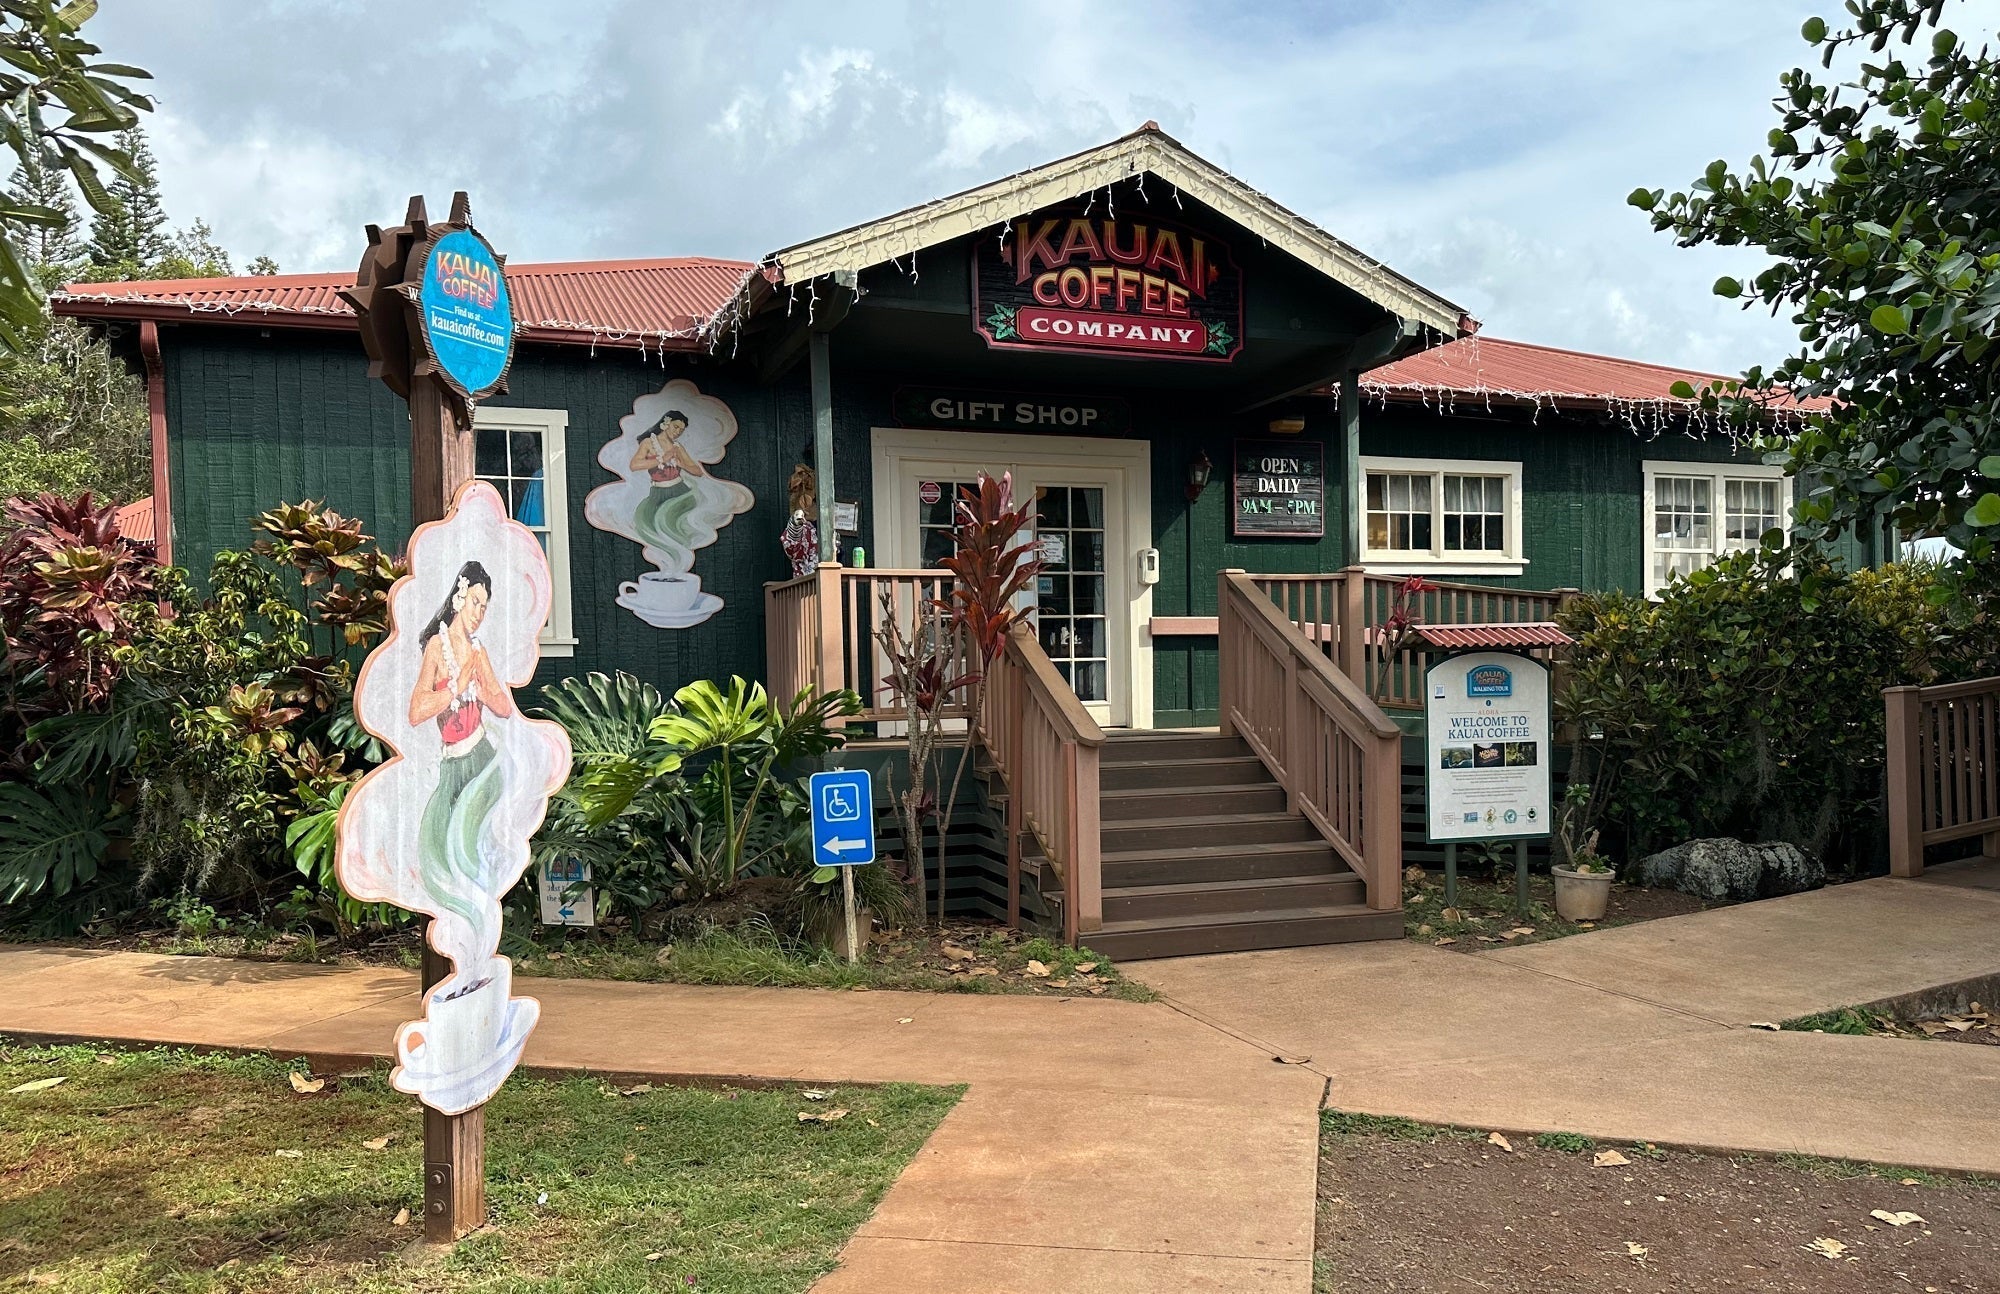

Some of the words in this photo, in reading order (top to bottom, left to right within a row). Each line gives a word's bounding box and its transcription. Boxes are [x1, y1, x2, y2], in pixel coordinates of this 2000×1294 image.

[464, 213, 473, 225] N
[1015, 218, 1206, 300] KAUAI
[436, 251, 498, 300] KAUAI
[408, 286, 419, 301] W
[442, 277, 494, 309] COFFEE
[1032, 264, 1191, 318] COFFEE
[454, 306, 468, 318] Find
[467, 312, 475, 320] us
[431, 311, 505, 347] kauaicoffee.com
[514, 321, 521, 333] E
[1030, 317, 1195, 344] COMPANY
[467, 397, 475, 411] S
[930, 398, 1005, 422] GIFT
[1015, 403, 1098, 426] SHOP
[1260, 457, 1299, 474] OPEN
[1257, 478, 1301, 494] DAILY
[1242, 498, 1273, 514] 9AM
[1287, 499, 1316, 515] 5PM
[1475, 671, 1506, 680] KAUAI
[1451, 716, 1509, 728] WELCOME
[1511, 715, 1527, 726] TO
[1448, 728, 1484, 739] KAUAI
[1487, 727, 1530, 738] COFFEE
